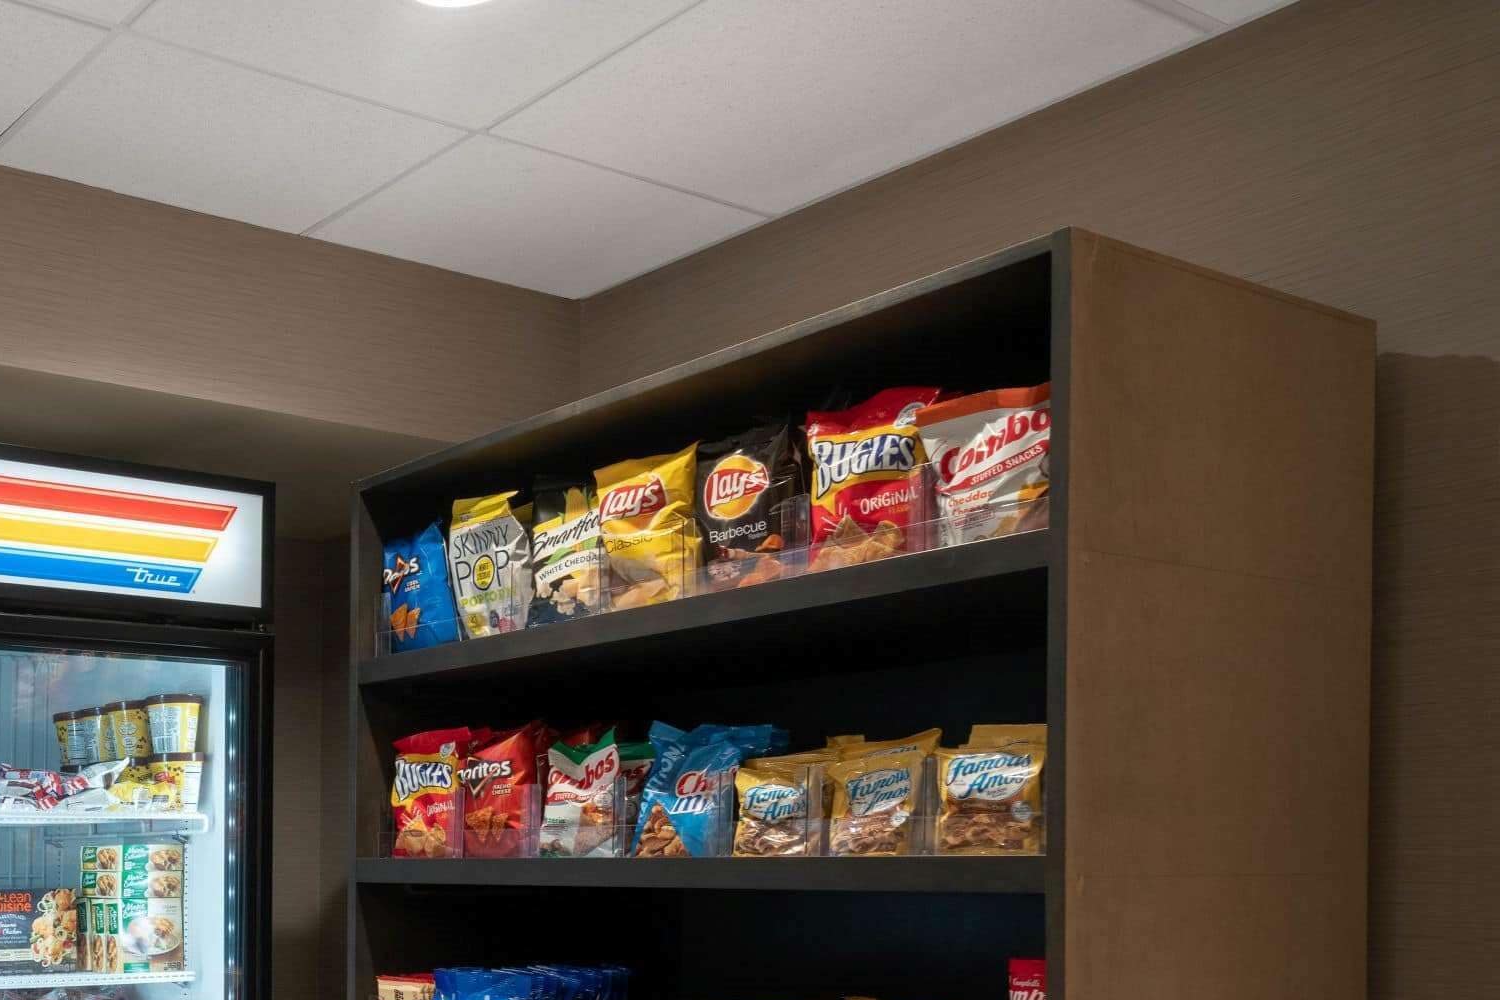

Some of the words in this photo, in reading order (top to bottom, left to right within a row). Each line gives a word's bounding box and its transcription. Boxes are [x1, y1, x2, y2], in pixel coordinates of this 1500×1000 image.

[940, 408, 1051, 484] Combo
[812, 435, 916, 500] BUGLES
[970, 463, 1003, 486] STUFFED
[1005, 445, 1043, 470] SNACKS
[601, 478, 660, 521] Lay's
[709, 467, 769, 508] Lay's
[453, 525, 509, 559] SKINNY
[604, 536, 653, 554] Classic
[709, 521, 767, 544] Barbecue
[126, 567, 181, 587] true
[454, 550, 510, 597] POP
[538, 563, 563, 582] WHITE
[394, 759, 454, 801] BUGLES
[848, 768, 911, 800] Famous
[945, 753, 1033, 787] Famous
[958, 772, 1025, 799] Amos
